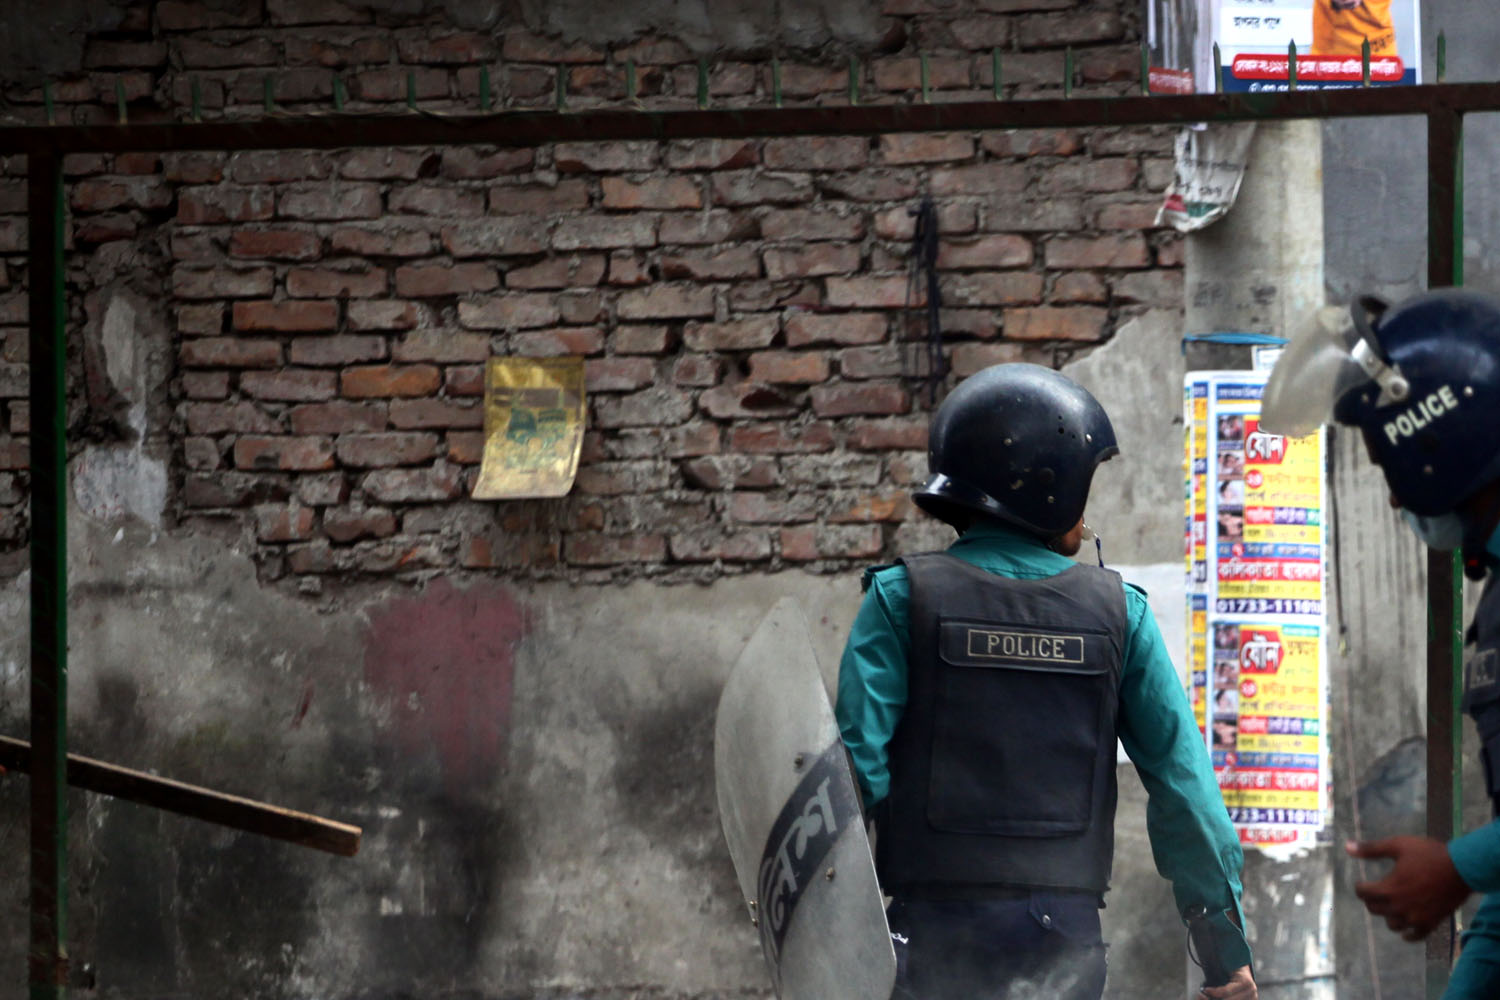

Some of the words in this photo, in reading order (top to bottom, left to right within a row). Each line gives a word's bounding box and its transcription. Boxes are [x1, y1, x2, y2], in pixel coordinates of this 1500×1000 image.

[1384, 385, 1459, 445] POLICE
[987, 635, 1065, 658] POLICE
[1241, 632, 1281, 669] যৌন
